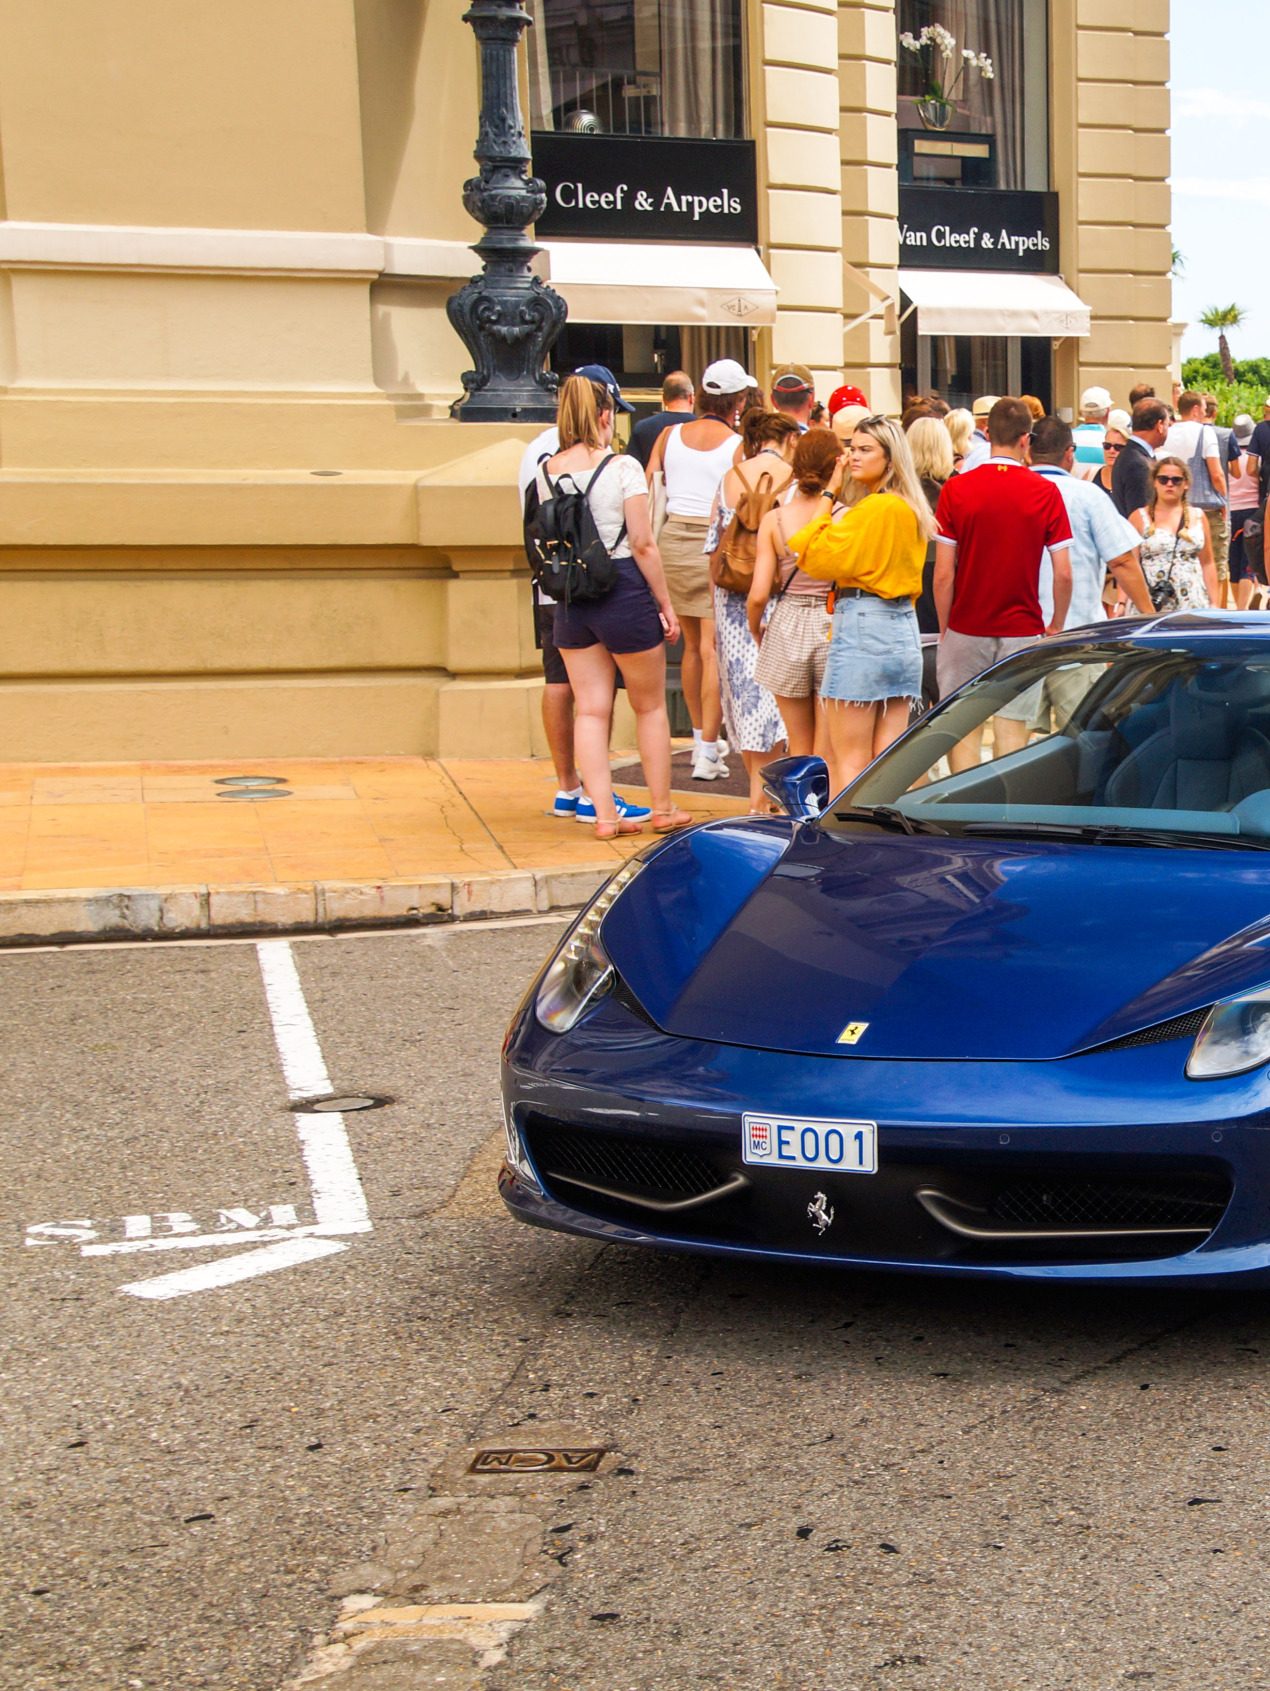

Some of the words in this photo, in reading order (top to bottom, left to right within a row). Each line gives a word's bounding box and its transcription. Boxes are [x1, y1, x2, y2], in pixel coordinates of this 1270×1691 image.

[555, 182, 628, 209] Cleef
[634, 190, 654, 211] &
[659, 186, 742, 220] Arpels
[931, 225, 978, 248] Cleef
[981, 232, 995, 249] &
[998, 229, 1050, 256] Arpels
[752, 1140, 768, 1151] MC
[777, 1124, 864, 1166] E001
